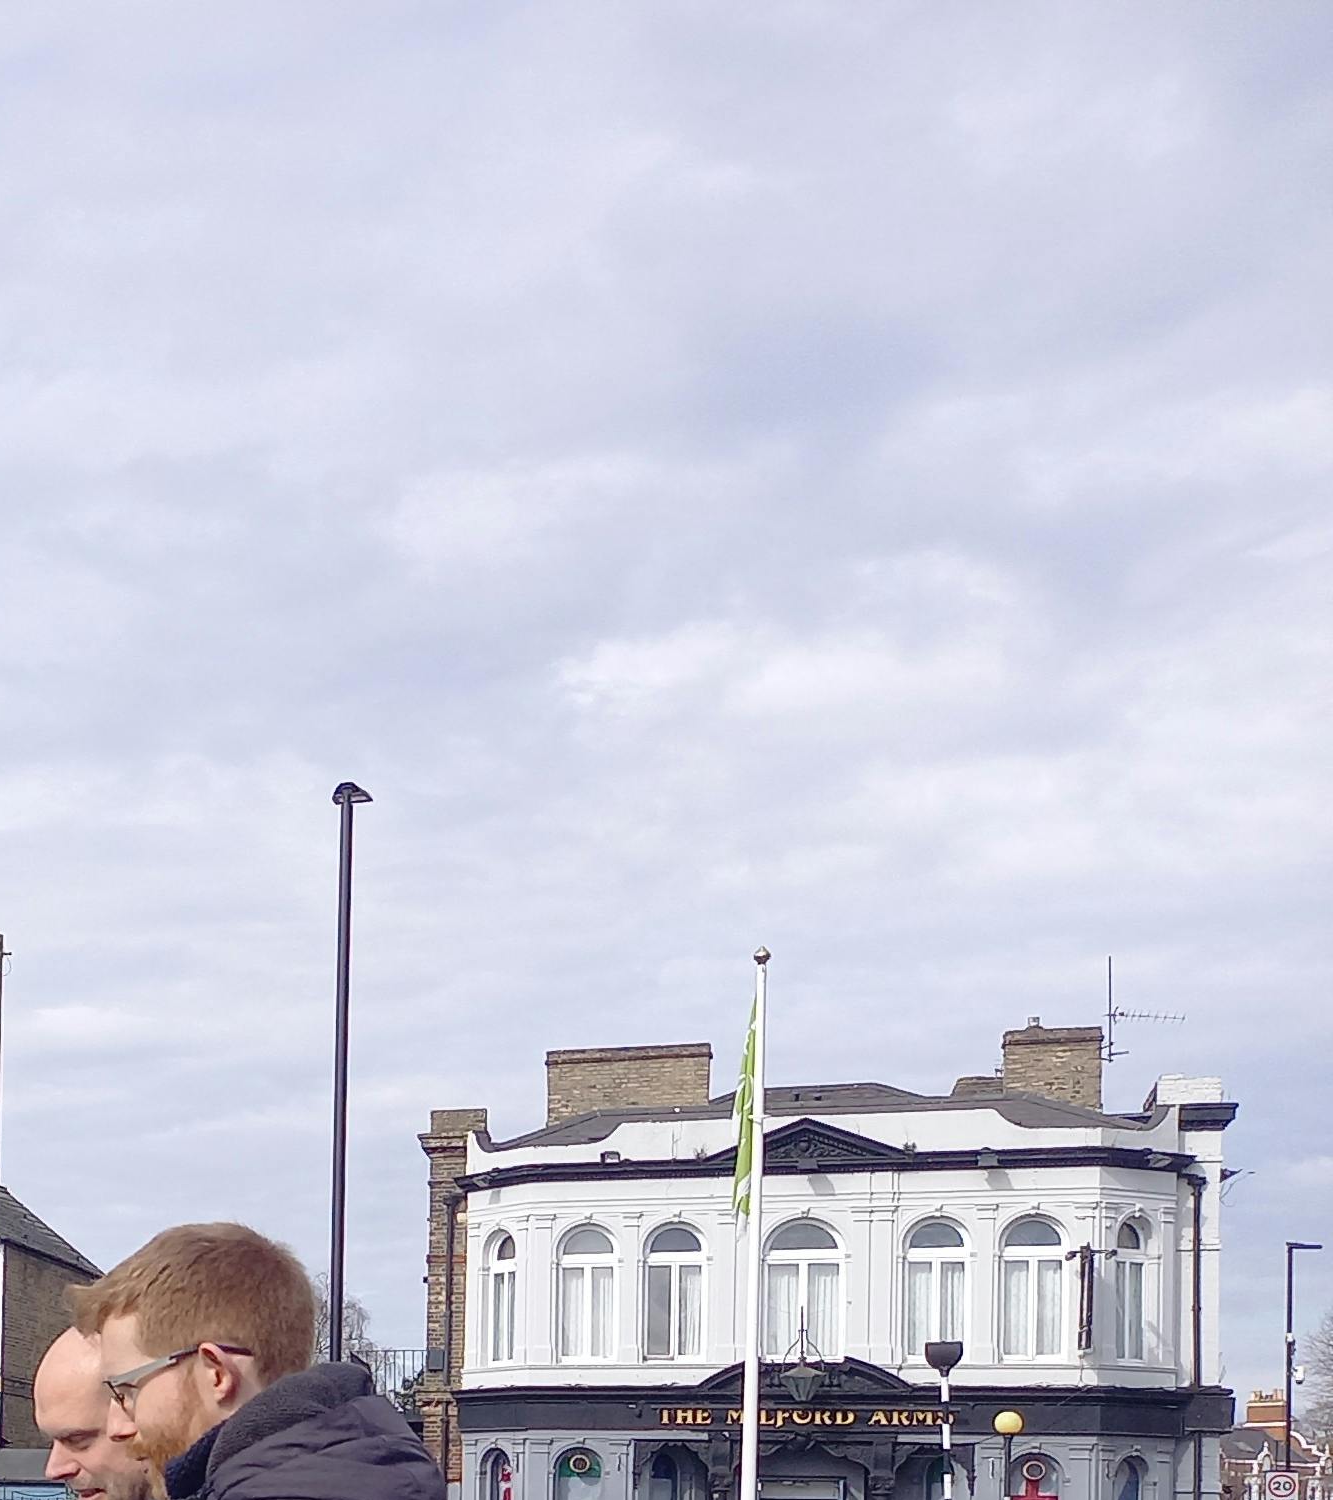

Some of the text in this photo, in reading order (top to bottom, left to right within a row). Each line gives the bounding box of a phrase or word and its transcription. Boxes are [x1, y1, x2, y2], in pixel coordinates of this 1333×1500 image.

[660, 1407, 712, 1424] THE
[726, 1407, 856, 1428] MLFORD
[1273, 1481, 1292, 1491] 20
